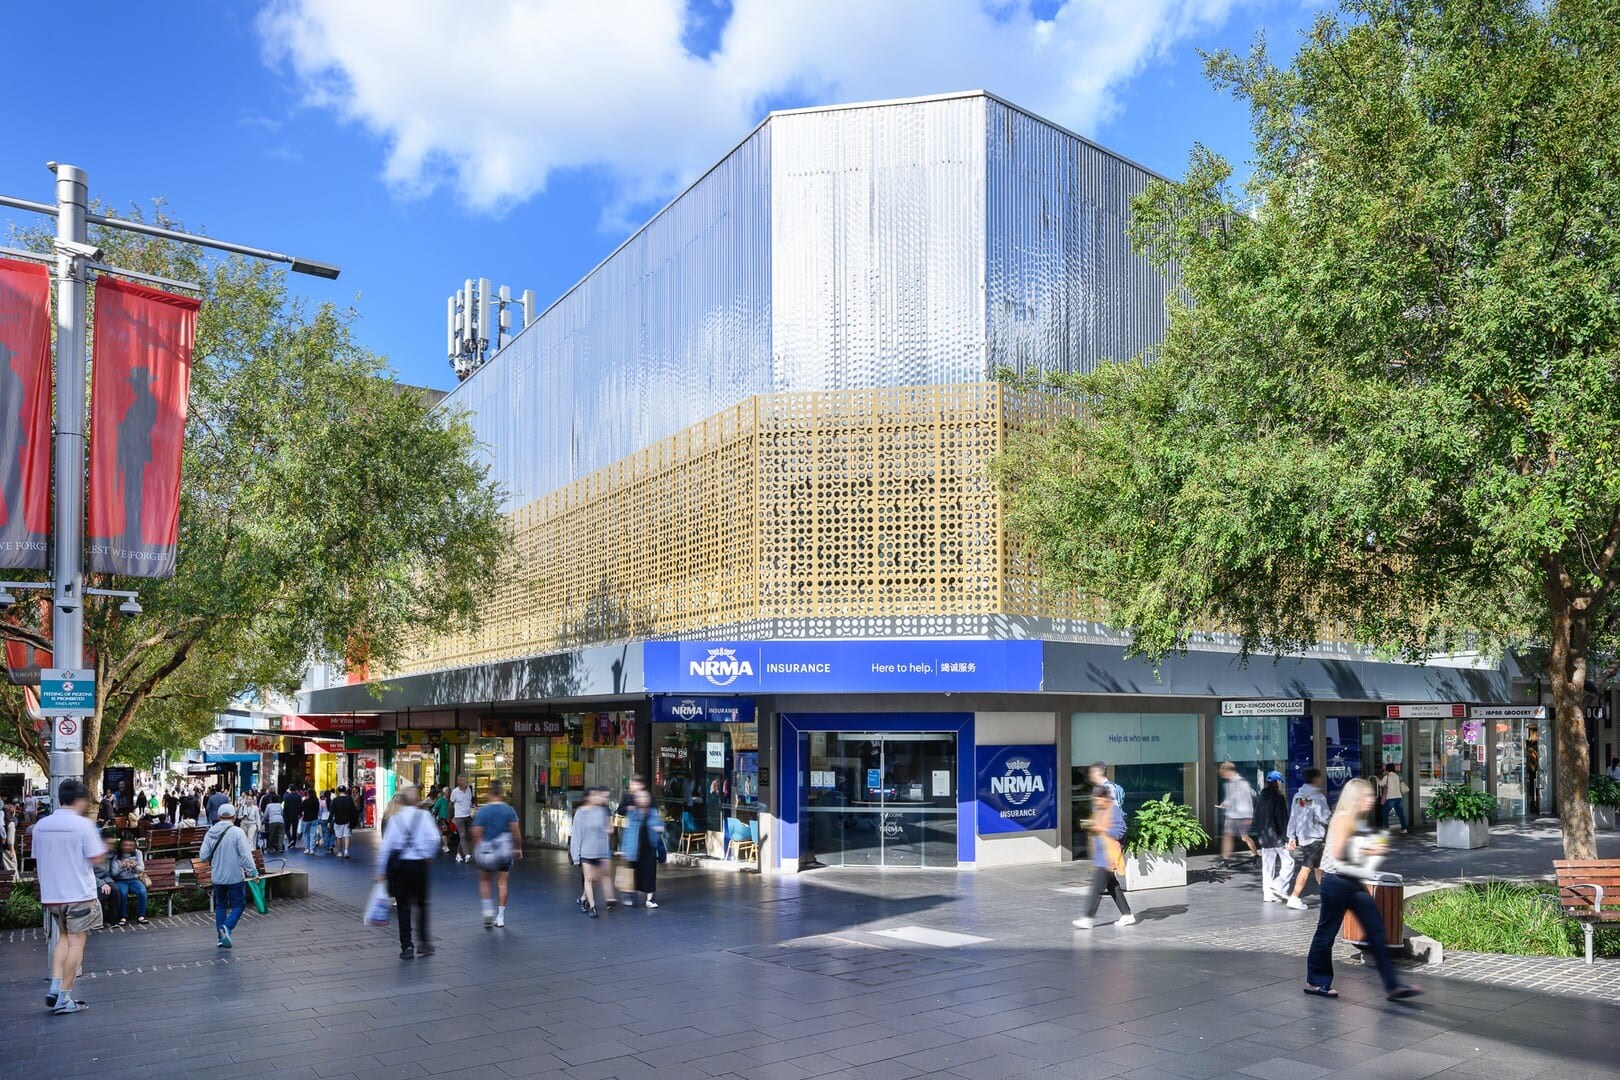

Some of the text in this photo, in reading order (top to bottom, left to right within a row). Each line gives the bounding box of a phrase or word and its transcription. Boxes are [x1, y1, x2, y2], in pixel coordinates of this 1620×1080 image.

[112, 549, 127, 558] WE
[130, 551, 169, 560] FORGET
[690, 661, 831, 676] NRMA INSURANCE
[871, 662, 934, 675] Here to help.
[672, 706, 703, 716] NRMA
[514, 721, 560, 733] Hair & Spa
[1109, 734, 1122, 744] Help
[1129, 734, 1142, 742] who
[991, 775, 1045, 794] NRMA
[1000, 809, 1036, 818] INSURANCE
